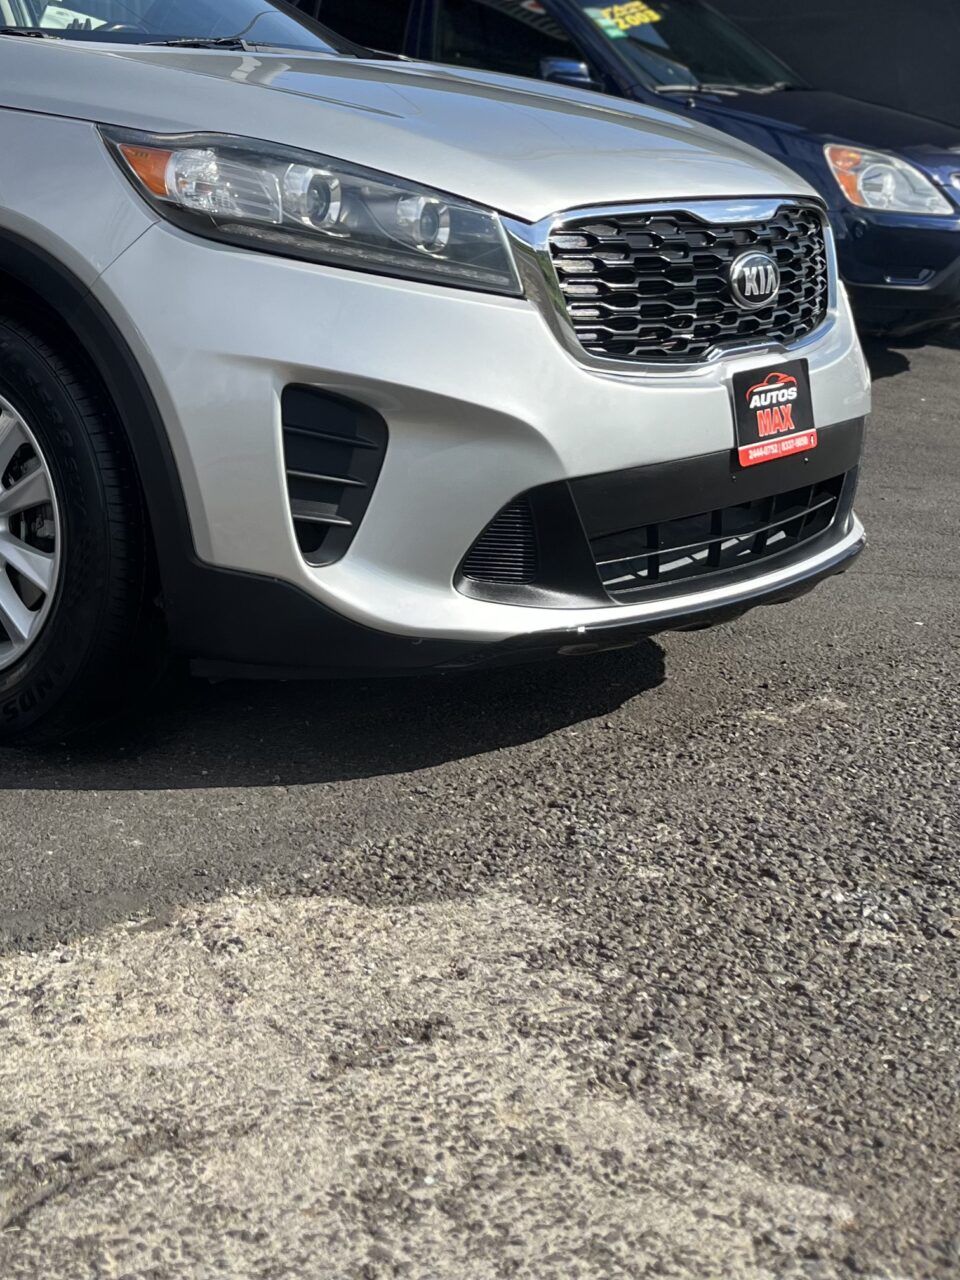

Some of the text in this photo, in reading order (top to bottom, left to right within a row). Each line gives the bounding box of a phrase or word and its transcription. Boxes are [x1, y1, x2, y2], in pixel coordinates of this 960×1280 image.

[743, 266, 777, 296] KIA
[749, 387, 797, 409] AUTOS
[757, 404, 795, 437] MAX
